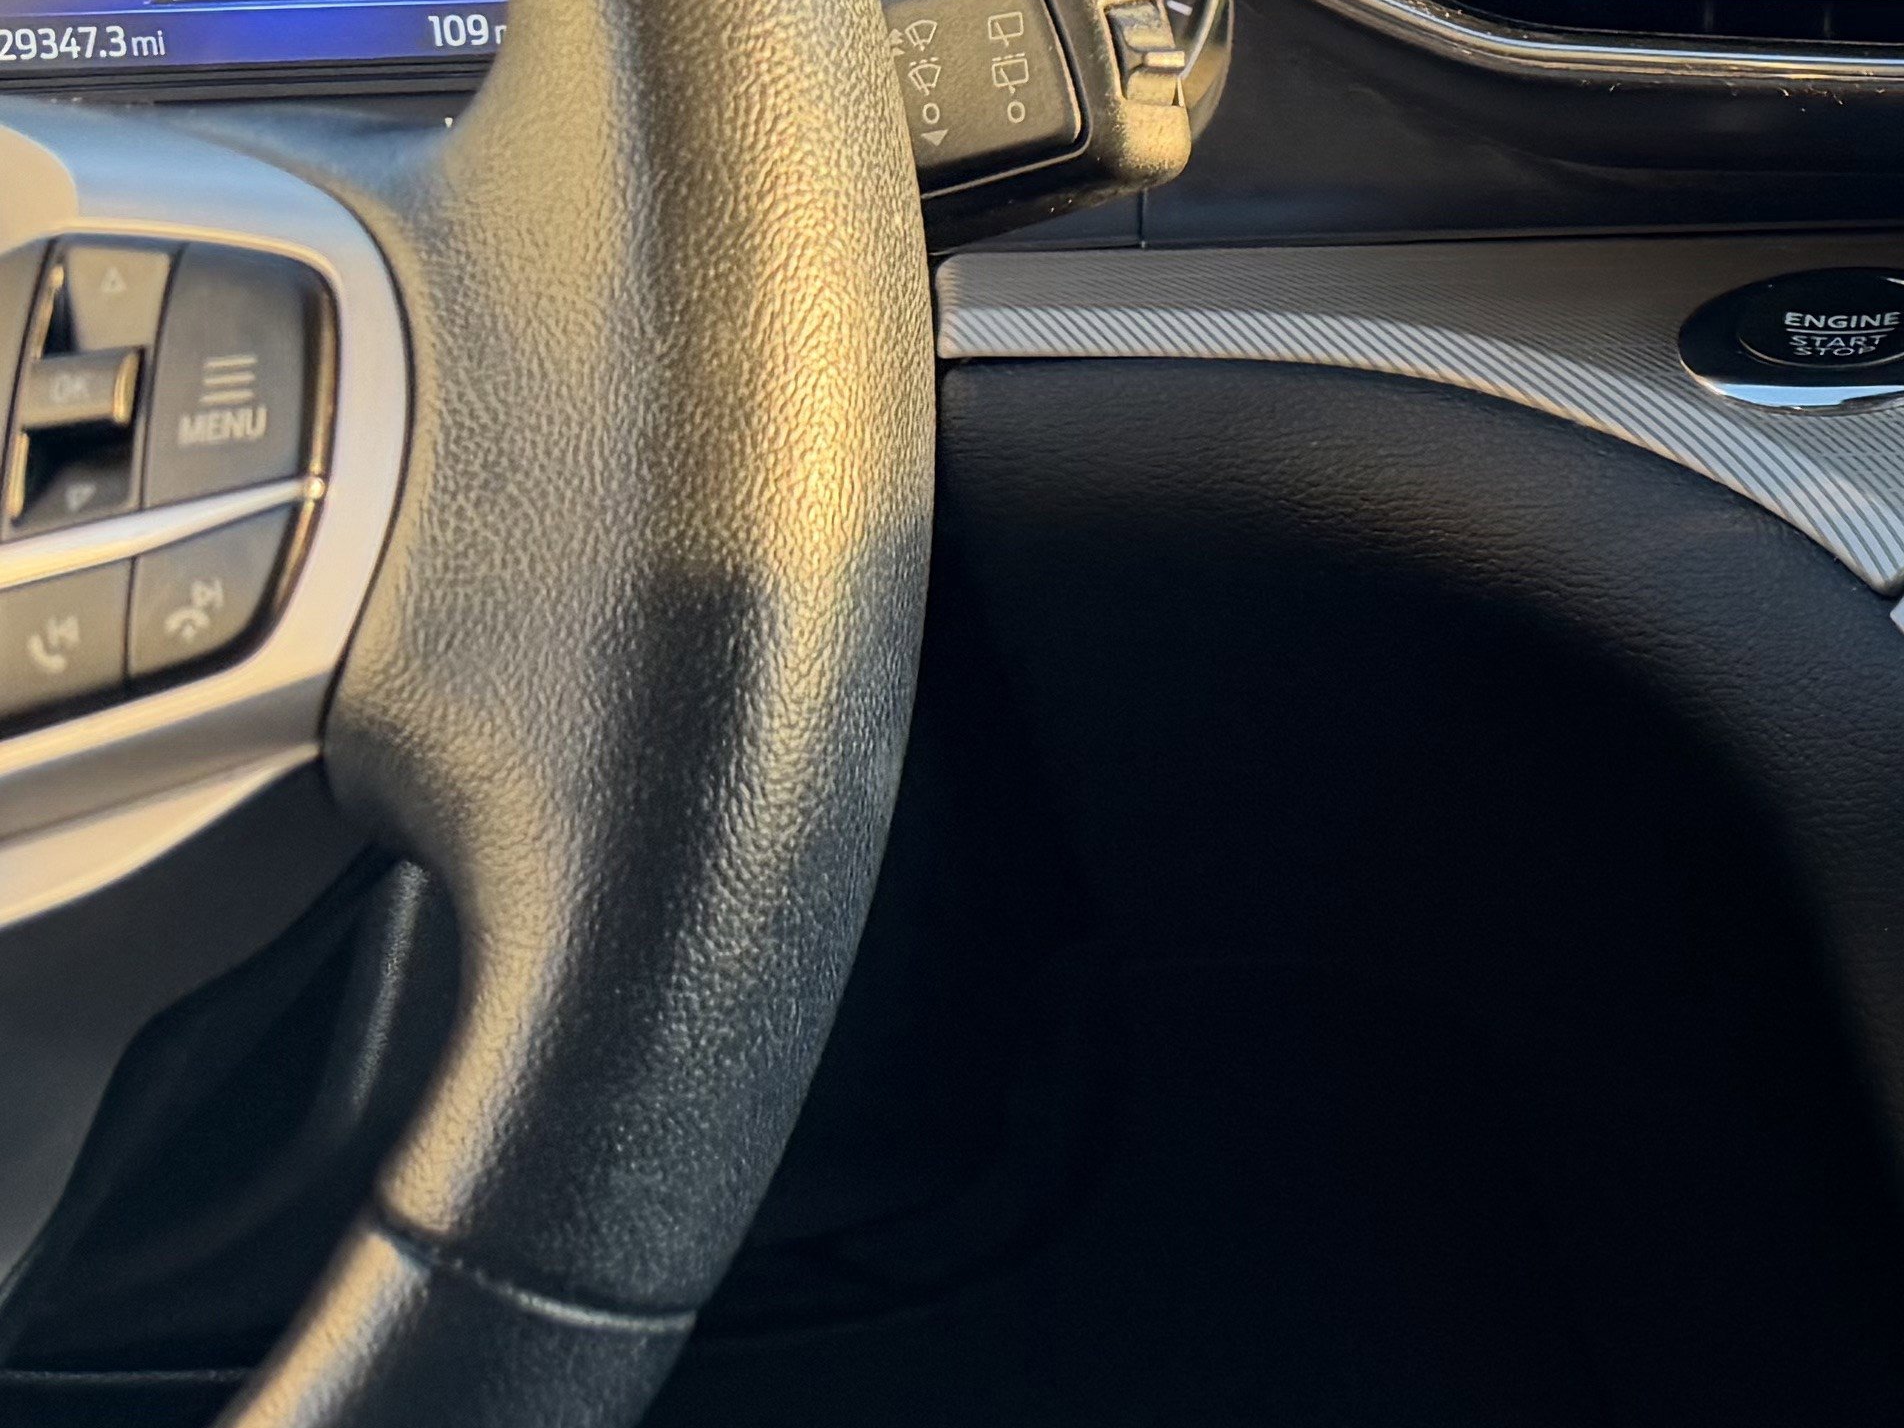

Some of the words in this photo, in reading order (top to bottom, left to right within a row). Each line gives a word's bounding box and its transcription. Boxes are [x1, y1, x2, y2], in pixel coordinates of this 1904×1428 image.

[0, 25, 127, 61] 29347.3
[131, 30, 166, 57] mi
[427, 13, 489, 47] 109
[1784, 311, 1901, 330] ENGINE
[1788, 334, 1888, 348] START
[1793, 346, 1876, 357] STOP
[177, 405, 268, 447] MENU
